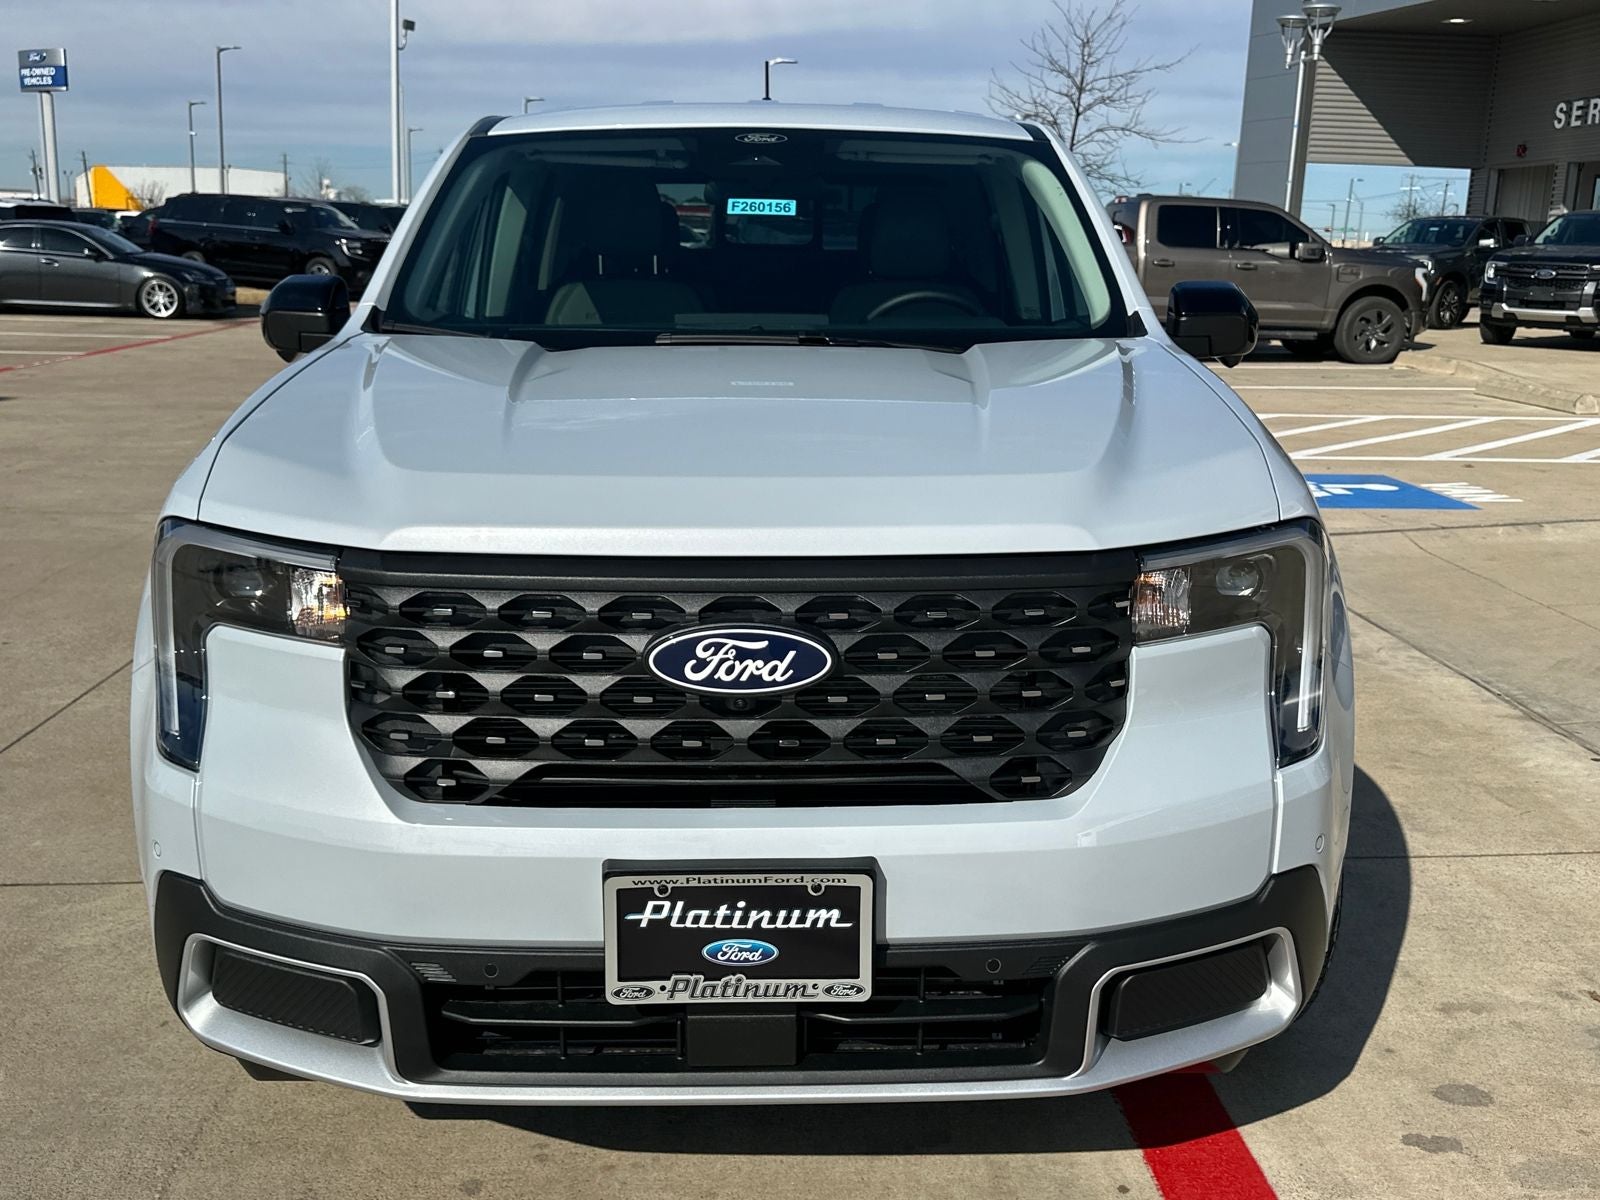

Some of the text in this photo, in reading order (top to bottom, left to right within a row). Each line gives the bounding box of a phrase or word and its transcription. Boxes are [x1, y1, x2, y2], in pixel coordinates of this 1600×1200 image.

[20, 67, 56, 76] PRE-OWNED
[23, 76, 53, 85] VEHICLES
[1554, 98, 1600, 129] SER
[744, 133, 778, 142] Ford
[731, 201, 792, 213] F260156
[684, 637, 797, 682] Ford
[632, 876, 848, 886] www.PlatinumFord.com
[624, 900, 853, 928] Platinum
[717, 943, 763, 962] Ford
[618, 987, 649, 999] Ford
[667, 975, 819, 1000] Platinum
[830, 985, 859, 997] Ford
